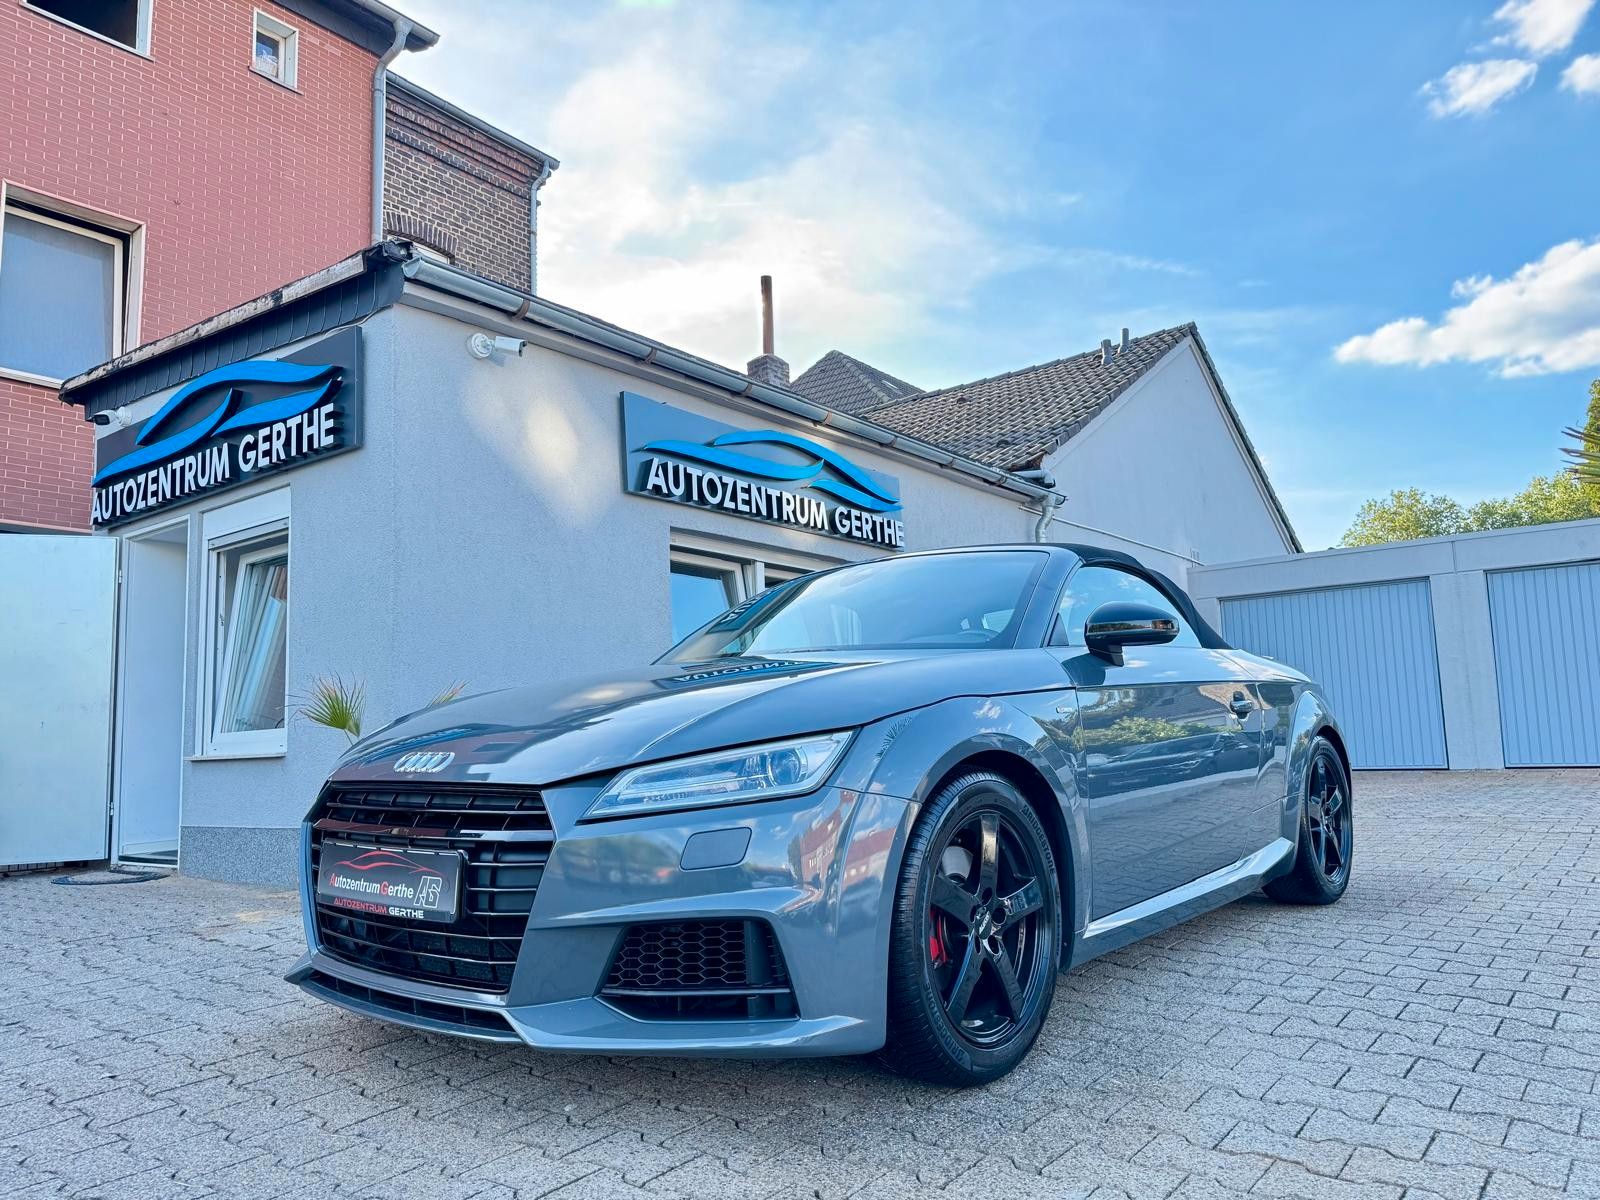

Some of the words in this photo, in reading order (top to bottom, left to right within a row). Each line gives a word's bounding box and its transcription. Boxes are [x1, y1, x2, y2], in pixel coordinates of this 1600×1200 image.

[90, 442, 230, 524] AUTOZENTRUM
[238, 402, 334, 473] GERTHE
[647, 457, 829, 531] AUTOZENTRUM
[834, 506, 905, 548] GERTHE
[329, 873, 414, 899] AutozentrumGerthe
[334, 897, 387, 914] AUTOZENTRUM
[388, 906, 425, 919] GERTHE
